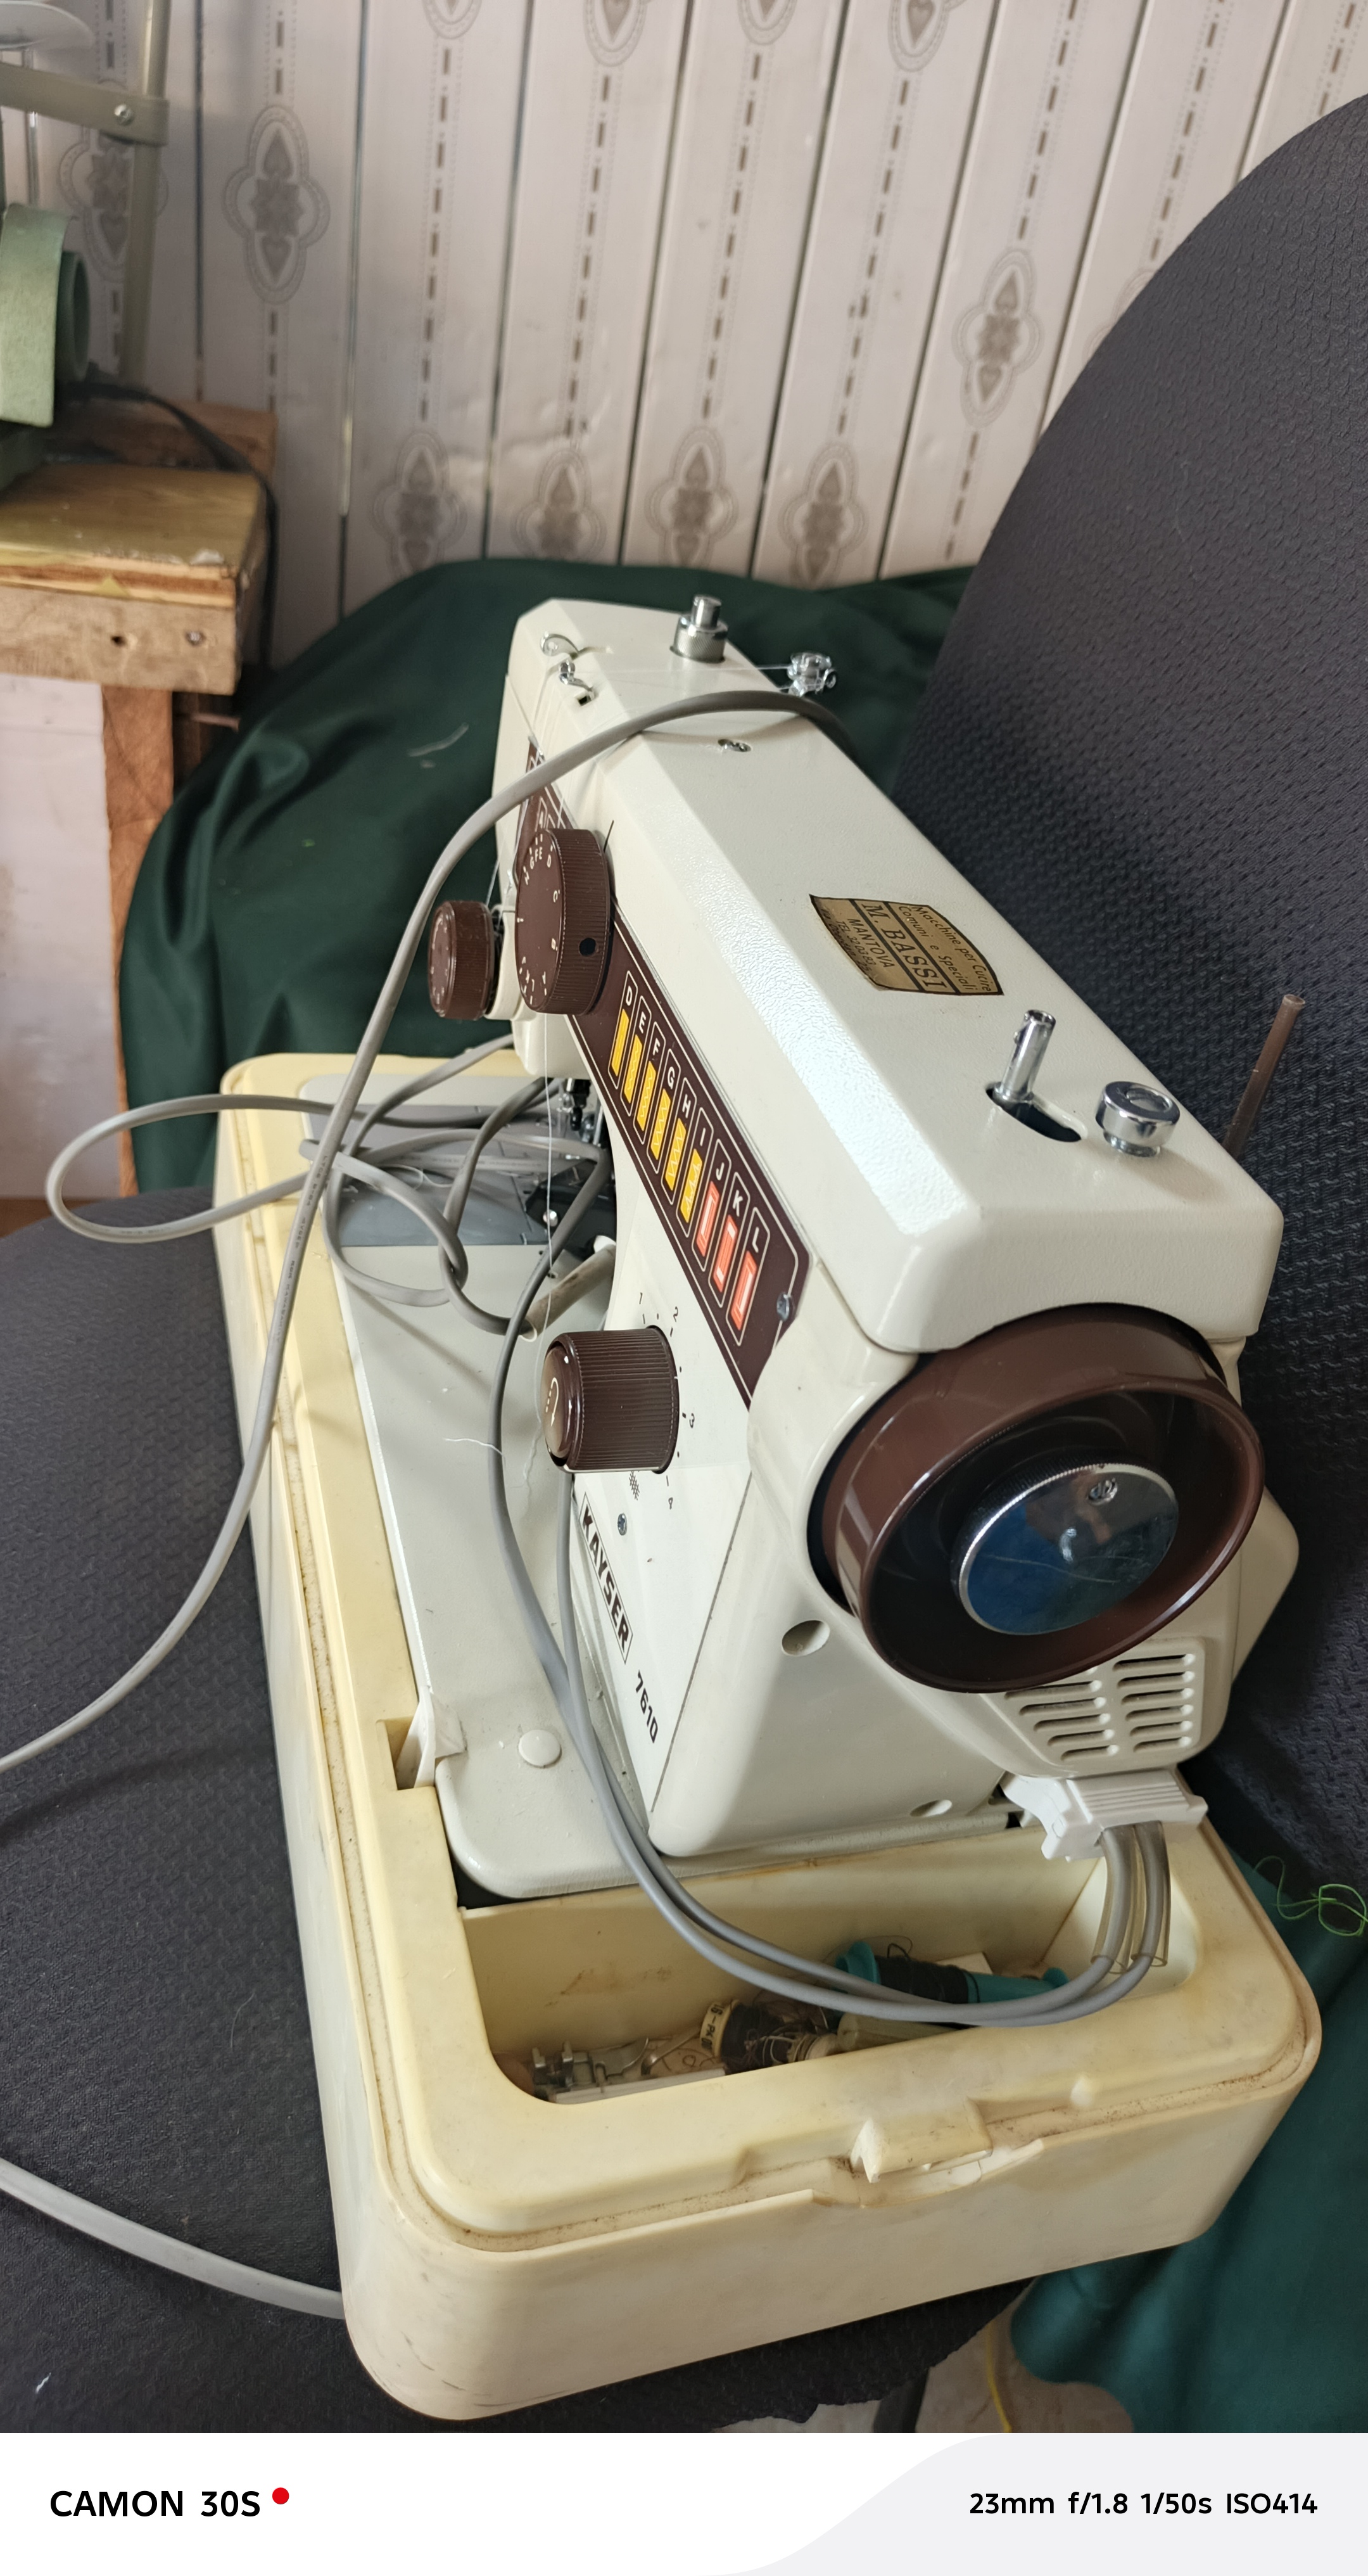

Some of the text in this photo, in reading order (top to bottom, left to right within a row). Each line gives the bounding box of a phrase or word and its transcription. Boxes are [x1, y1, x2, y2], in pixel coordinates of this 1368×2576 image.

[847, 919, 895, 968] MANTOVA
[861, 903, 948, 989] M. BASSI
[899, 906, 934, 938] Comuni
[938, 955, 978, 991] Speciali
[911, 906, 992, 992] Macchine per Cucire
[626, 985, 633, 1006] D
[638, 1011, 646, 1034] E
[652, 1038, 660, 1055] F
[667, 1066, 675, 1089] G
[682, 1094, 691, 1118] H
[700, 1128, 706, 1146] I
[716, 1163, 725, 1180] J
[732, 1190, 743, 1216] K
[752, 1227, 759, 1253] L
[639, 1292, 643, 1304] 1
[673, 1306, 678, 1322] 2
[689, 1413, 695, 1429] 3
[583, 1503, 629, 1652] KAYSER
[635, 1669, 658, 1744] 7610
